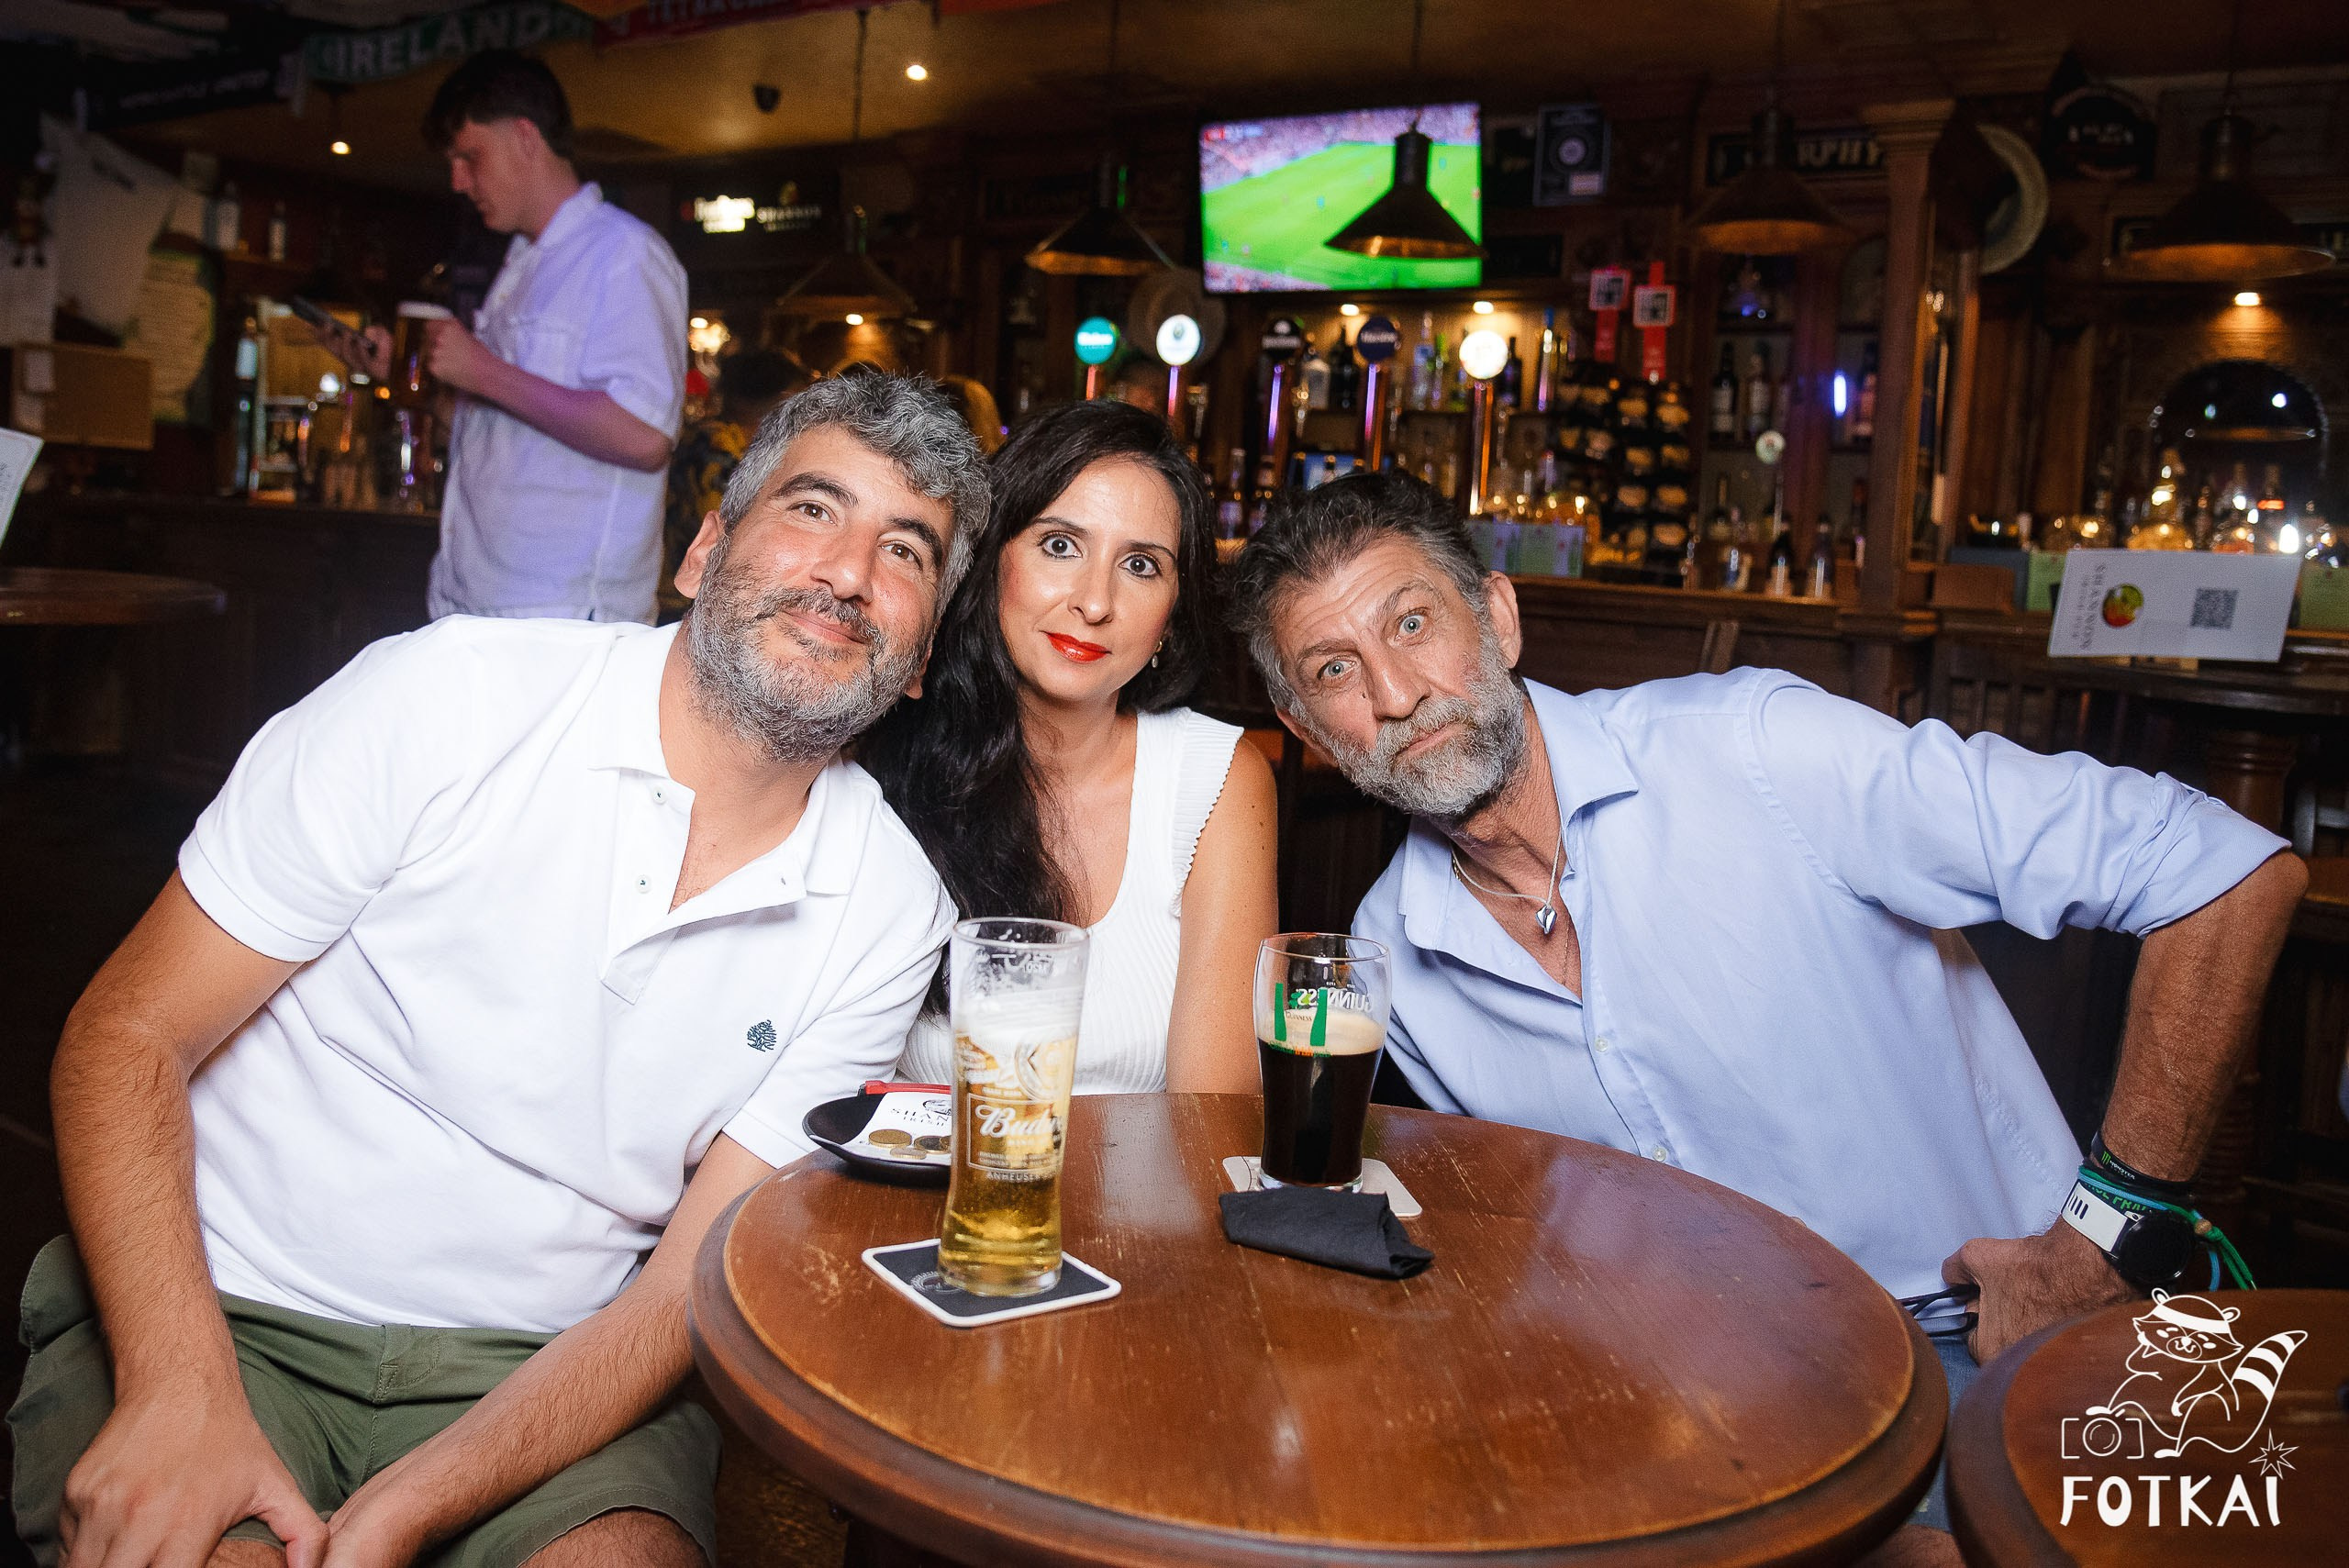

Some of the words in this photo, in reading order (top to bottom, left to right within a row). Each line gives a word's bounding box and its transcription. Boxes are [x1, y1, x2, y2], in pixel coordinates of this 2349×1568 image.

[336, 5, 551, 76] IRELAND
[891, 1107, 951, 1121] SHAN
[2110, 1160, 2136, 1181] MONSTER
